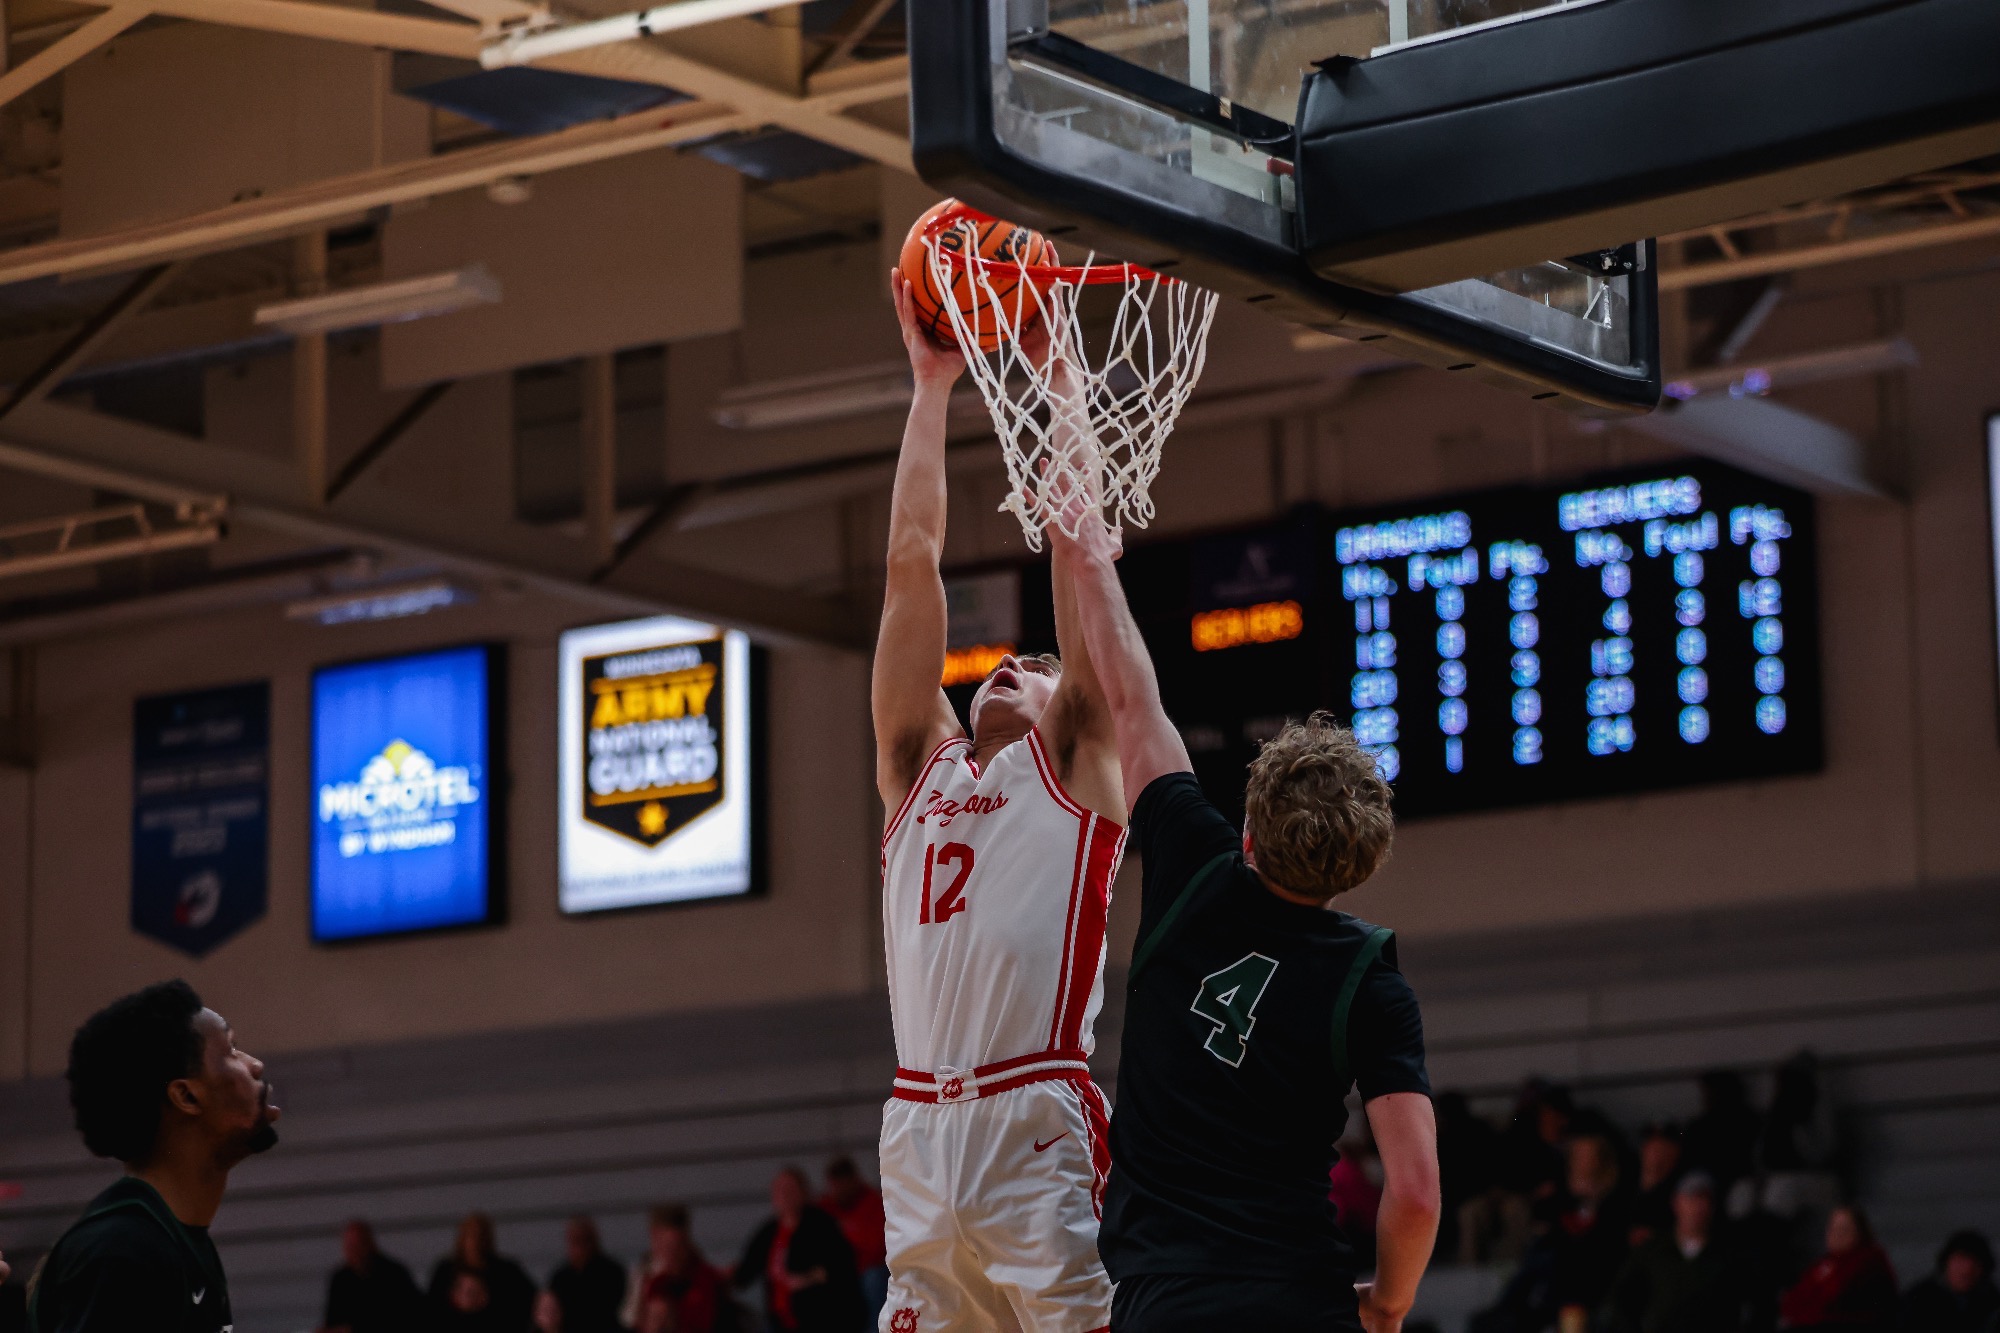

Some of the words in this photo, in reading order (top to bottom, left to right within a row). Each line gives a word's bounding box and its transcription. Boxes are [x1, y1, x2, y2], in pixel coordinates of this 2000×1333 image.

[589, 679, 716, 729] ARMY
[588, 744, 718, 796] GUARD
[919, 841, 975, 926] 12
[1190, 951, 1279, 1069] 4
